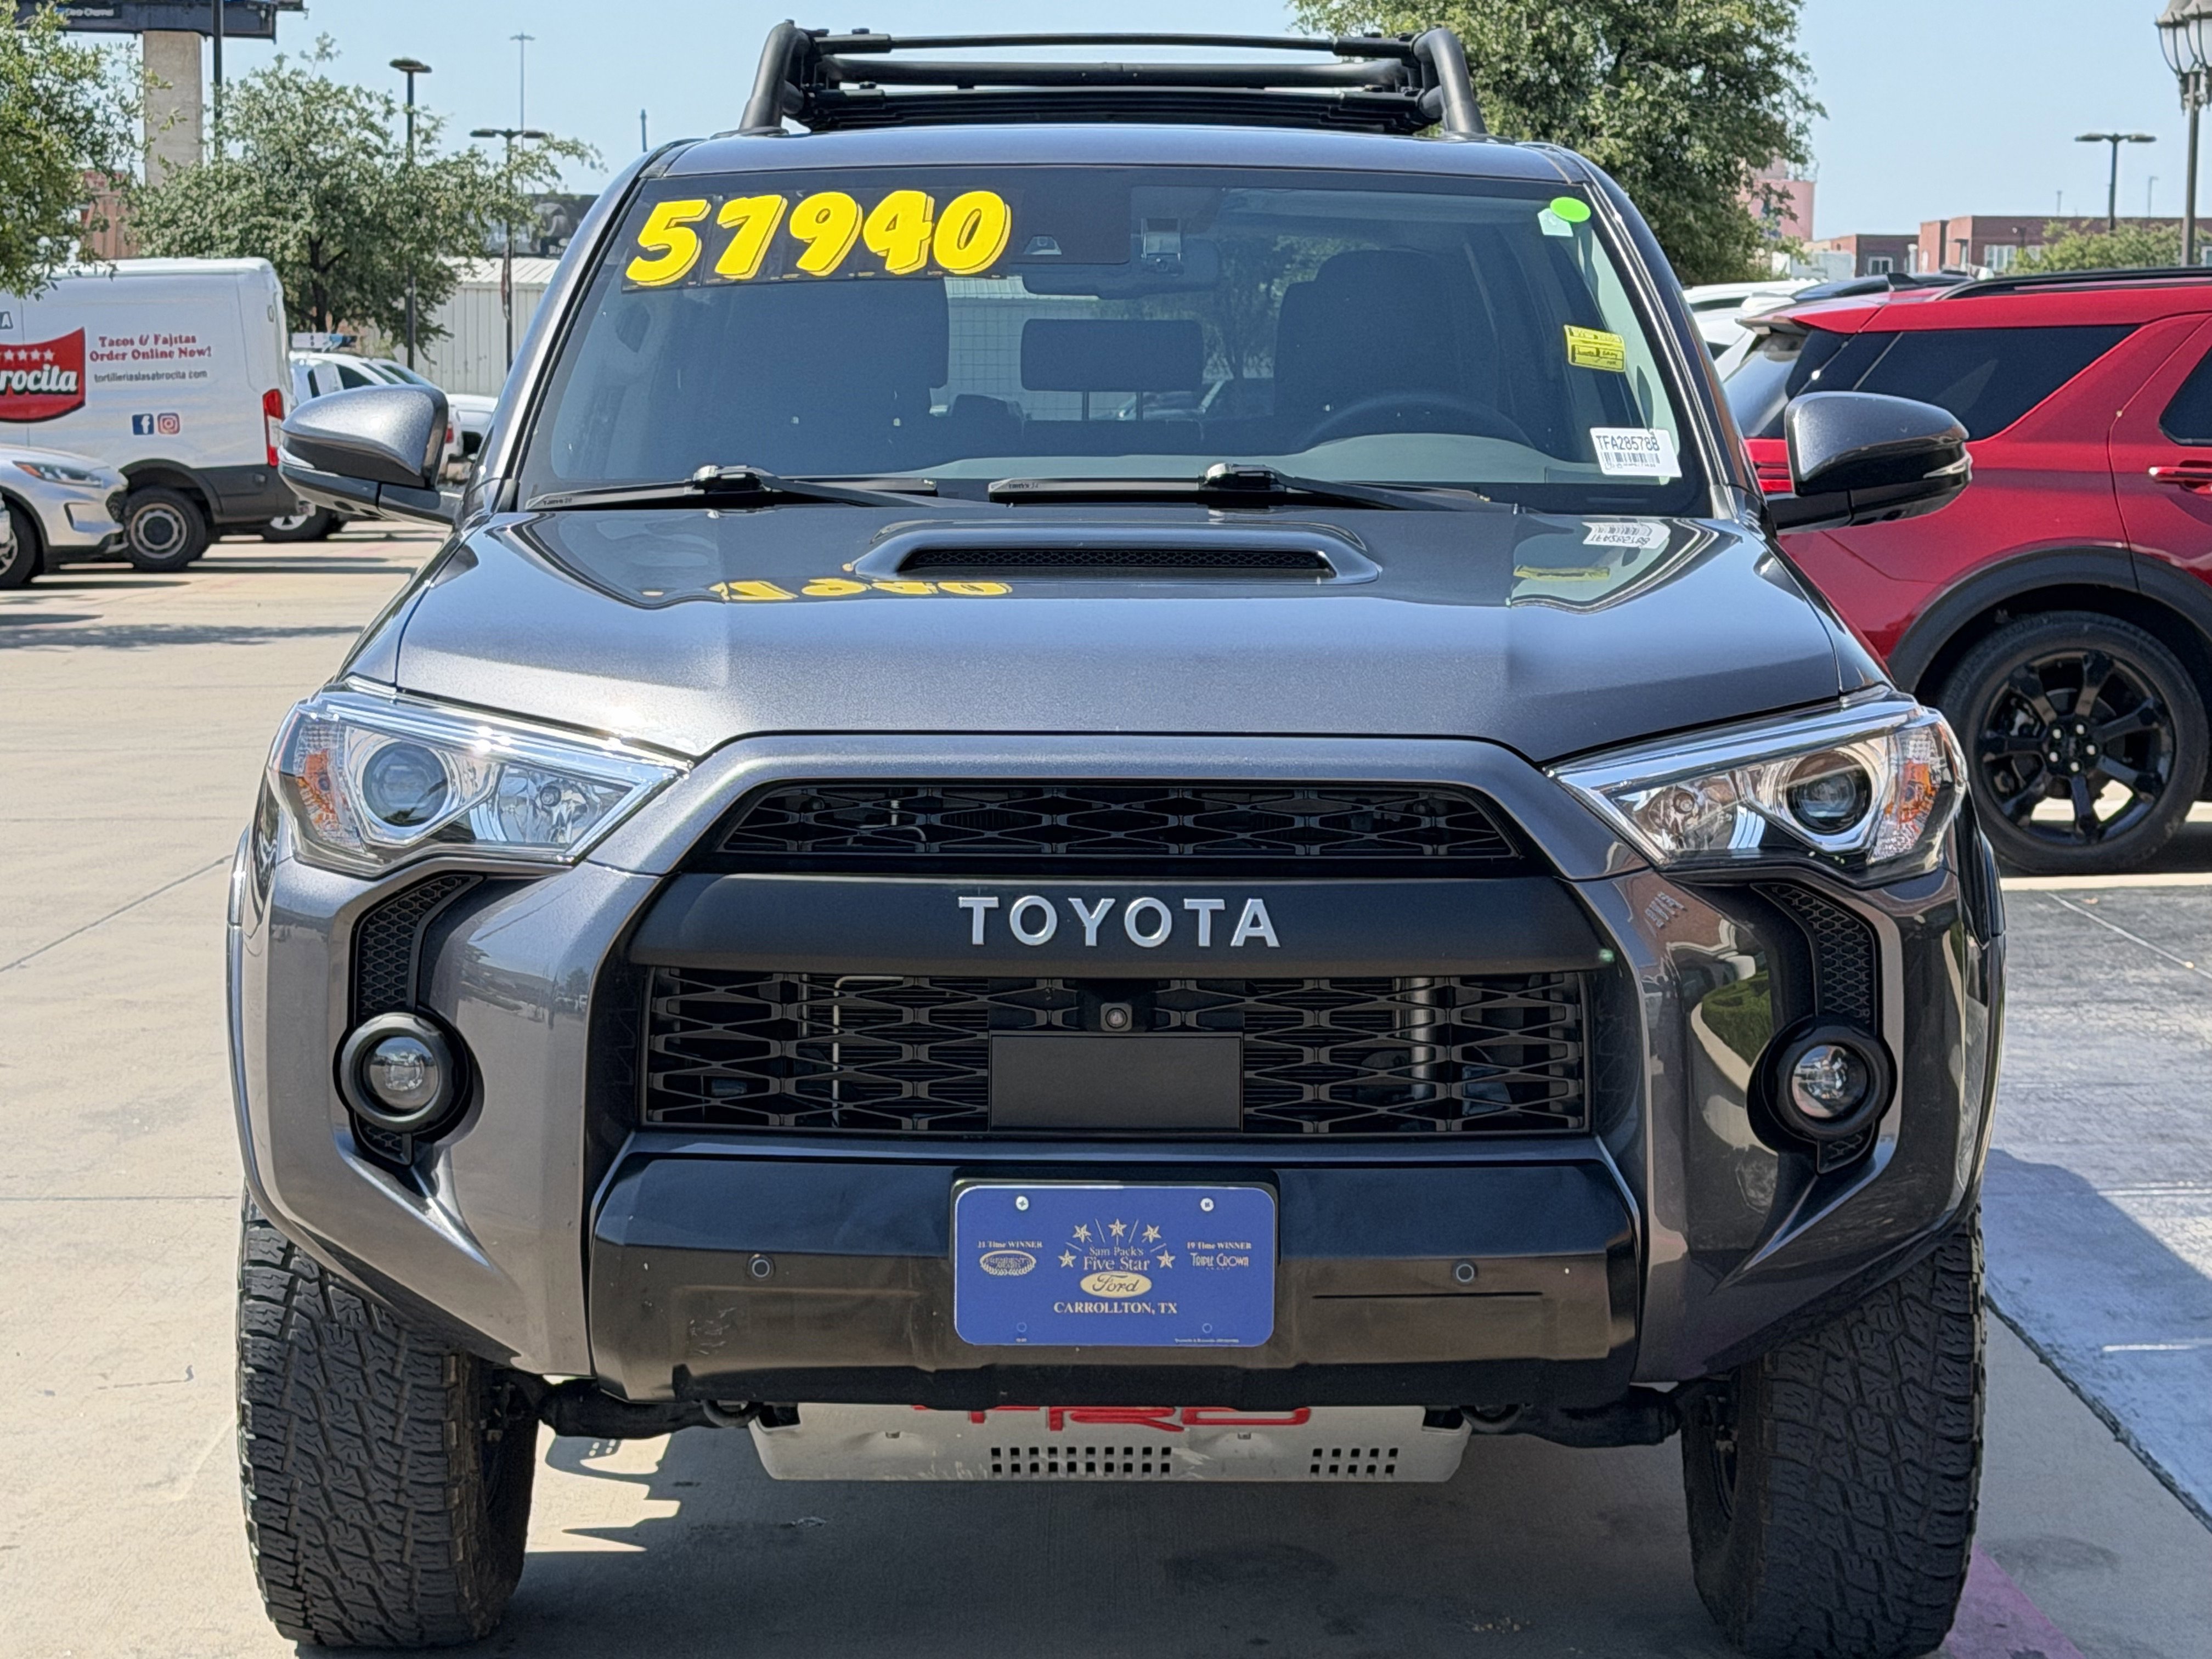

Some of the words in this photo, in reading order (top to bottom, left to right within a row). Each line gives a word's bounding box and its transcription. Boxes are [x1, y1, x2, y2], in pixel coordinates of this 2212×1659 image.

[625, 190, 1012, 286] 57940
[99, 336, 134, 347] Tacos
[154, 333, 196, 347] Fajitas
[89, 350, 127, 362] Order
[131, 348, 175, 360] Online
[178, 345, 212, 358] Now!
[958, 895, 1280, 947] TOYOTA
[1008, 1240, 1043, 1249] WINNER
[1089, 1246, 1110, 1256] Sam
[1084, 1256, 1115, 1271] Five
[1120, 1256, 1150, 1271] Star
[1092, 1273, 1139, 1292] Ford
[1054, 1301, 1156, 1314] CARROLLTON,
[1158, 1302, 1177, 1314] TX
